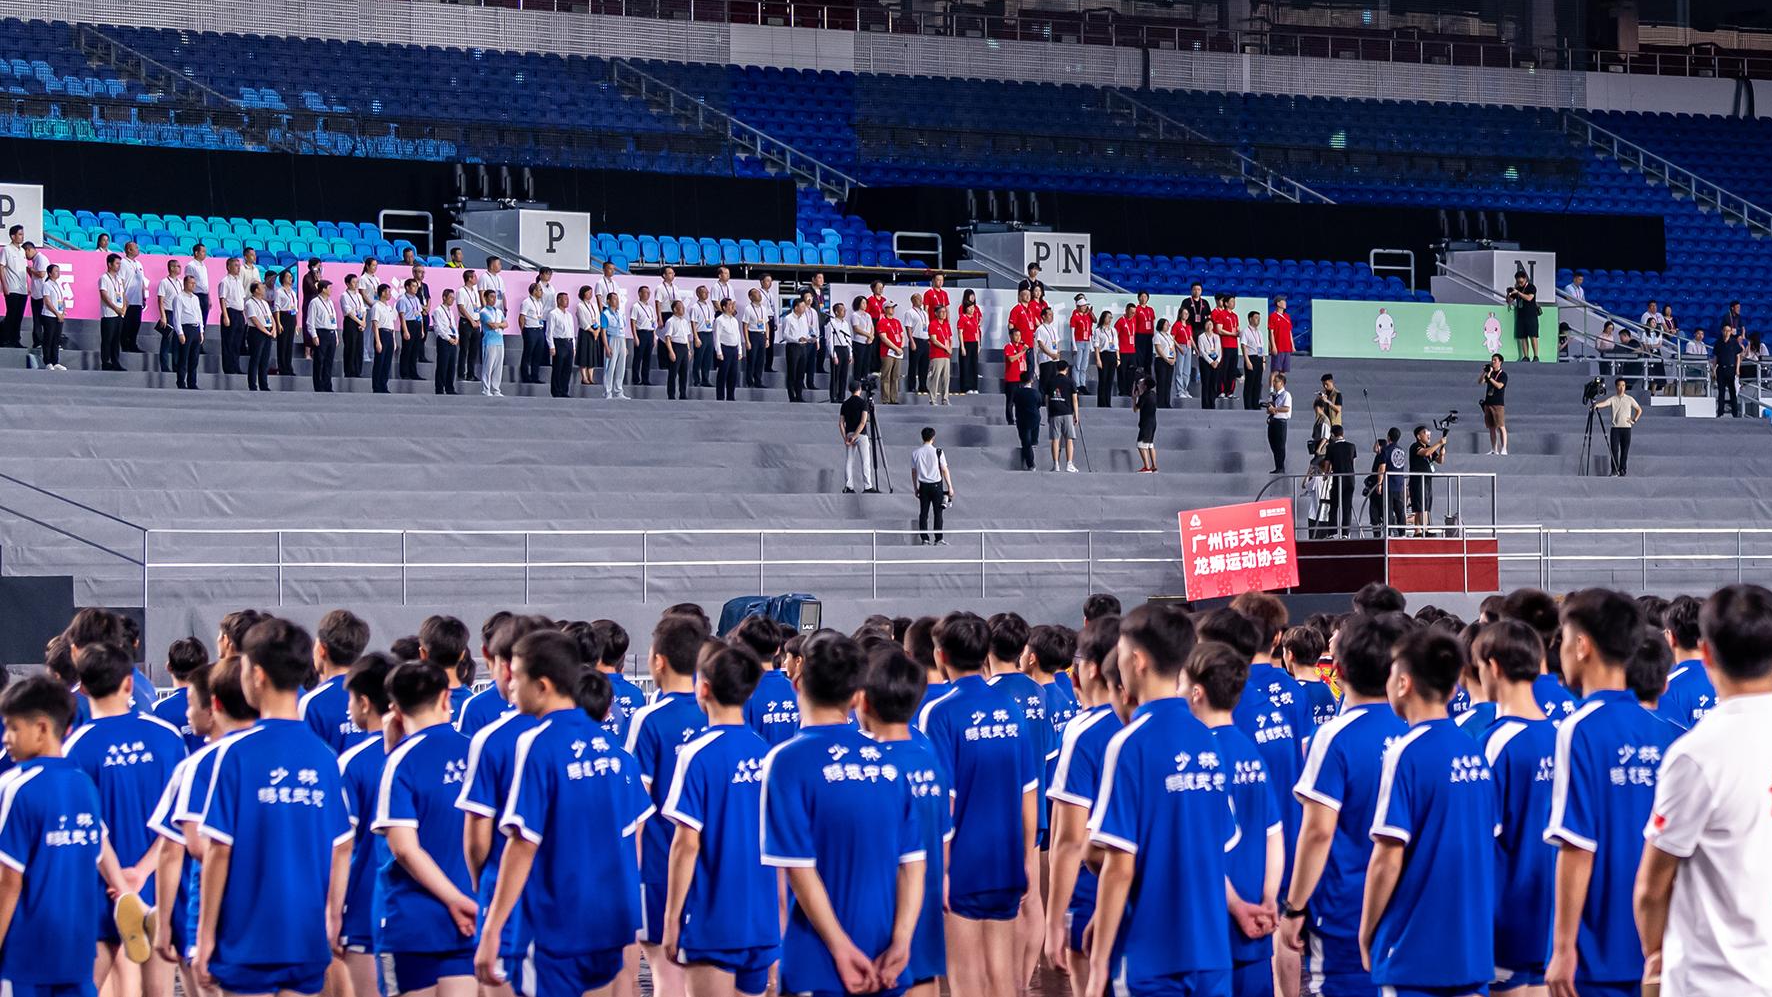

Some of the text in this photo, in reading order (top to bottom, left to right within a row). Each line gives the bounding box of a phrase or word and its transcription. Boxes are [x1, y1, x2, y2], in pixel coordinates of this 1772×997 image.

[545, 220, 565, 254] P
[1191, 523, 1286, 554] 广州市天河区
[1193, 546, 1288, 576] 龙狮运动协会
[971, 710, 1009, 725] 少林
[1544, 701, 1575, 715] 少林
[1256, 712, 1283, 726] 少林
[828, 744, 882, 761] 少林
[1174, 751, 1220, 771] 少林
[1618, 745, 1662, 764] 少林
